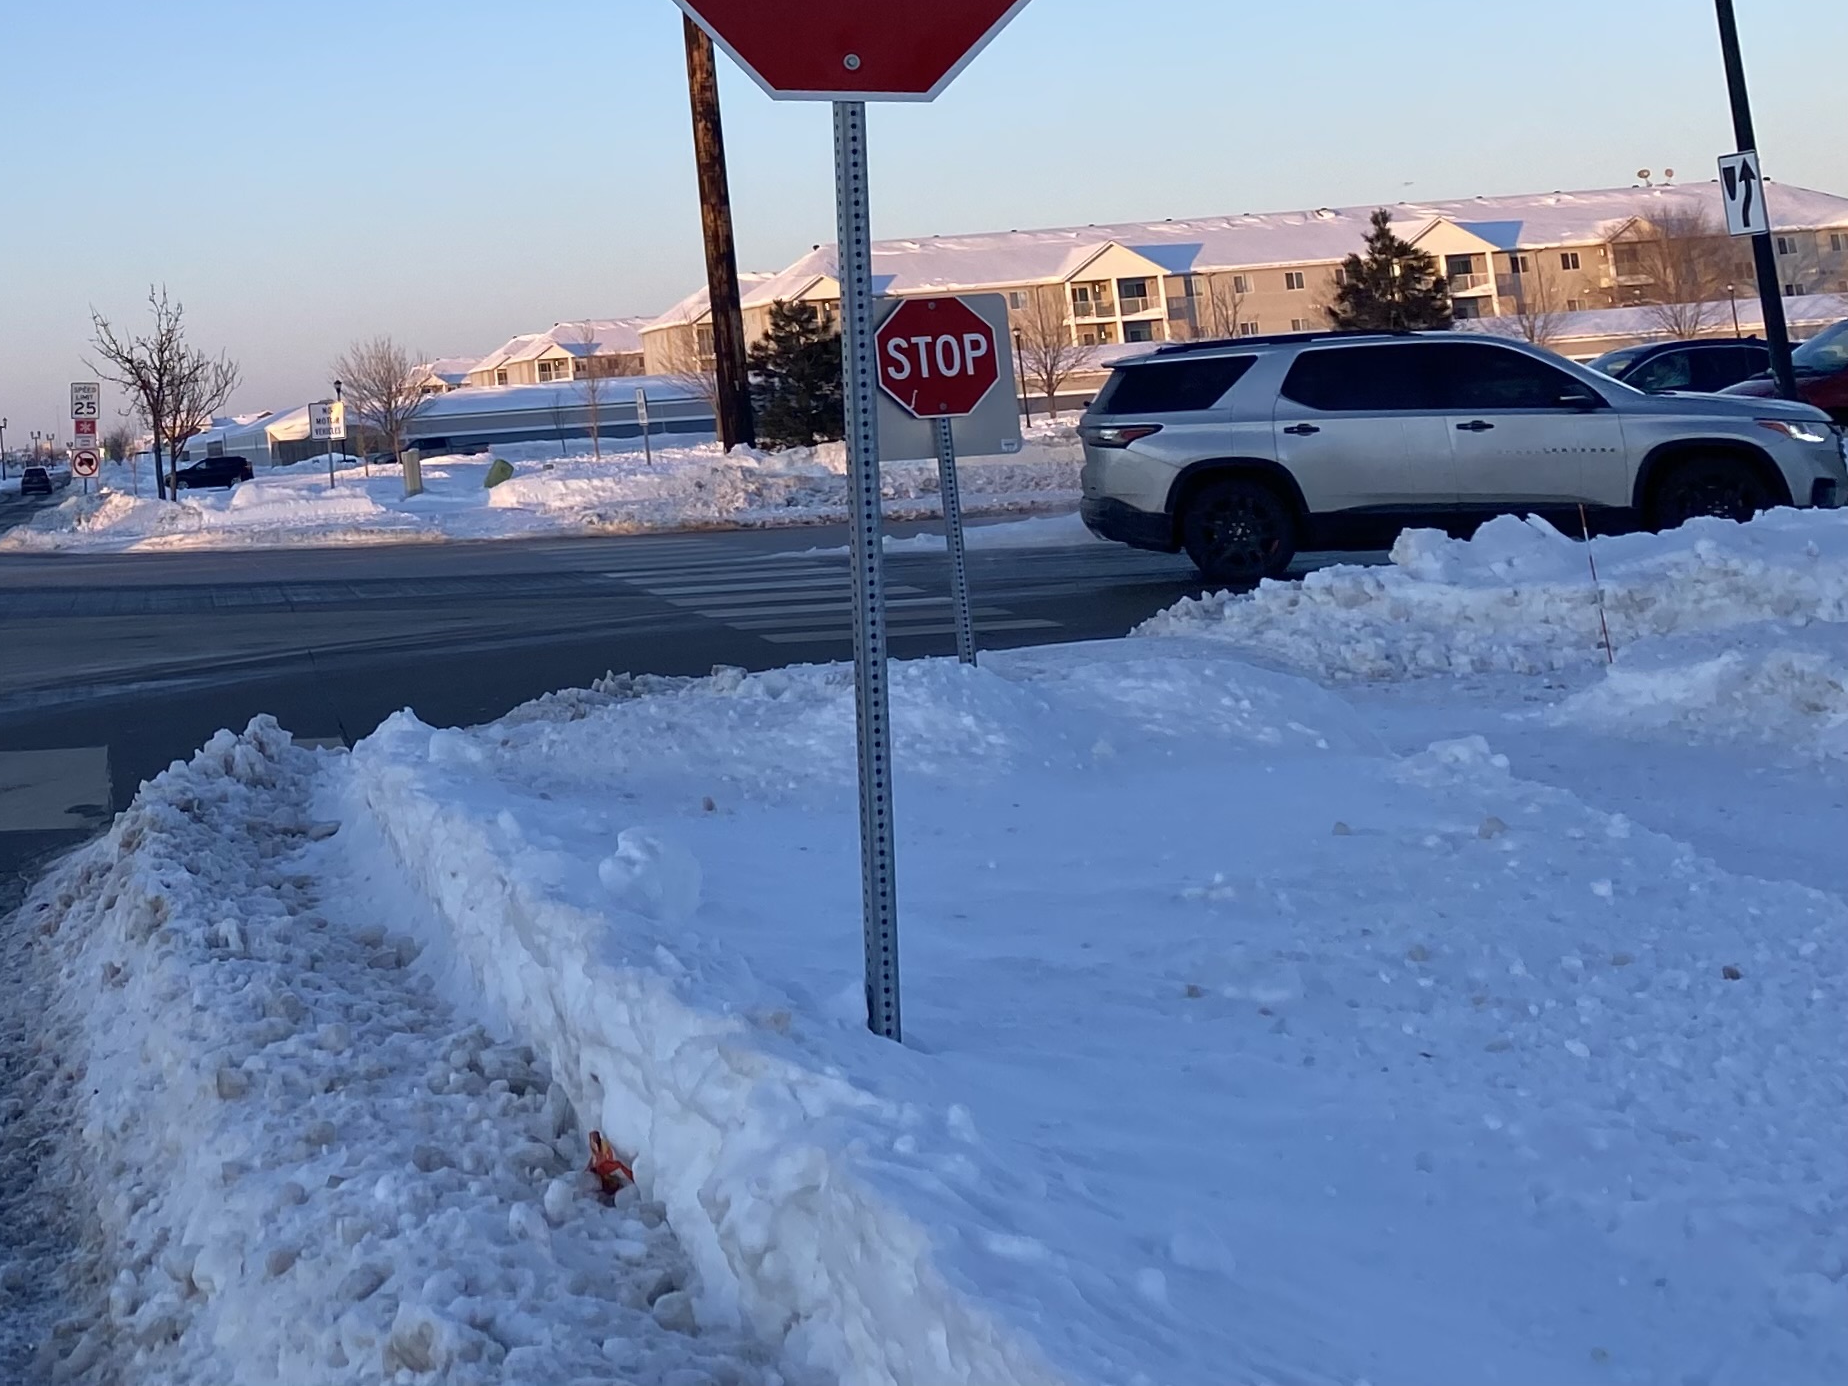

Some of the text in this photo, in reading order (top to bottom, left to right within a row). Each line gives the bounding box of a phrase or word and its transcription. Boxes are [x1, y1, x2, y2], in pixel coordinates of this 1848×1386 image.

[887, 333, 988, 380] STOP
[74, 386, 96, 394] SPEED
[74, 401, 96, 415] 25
